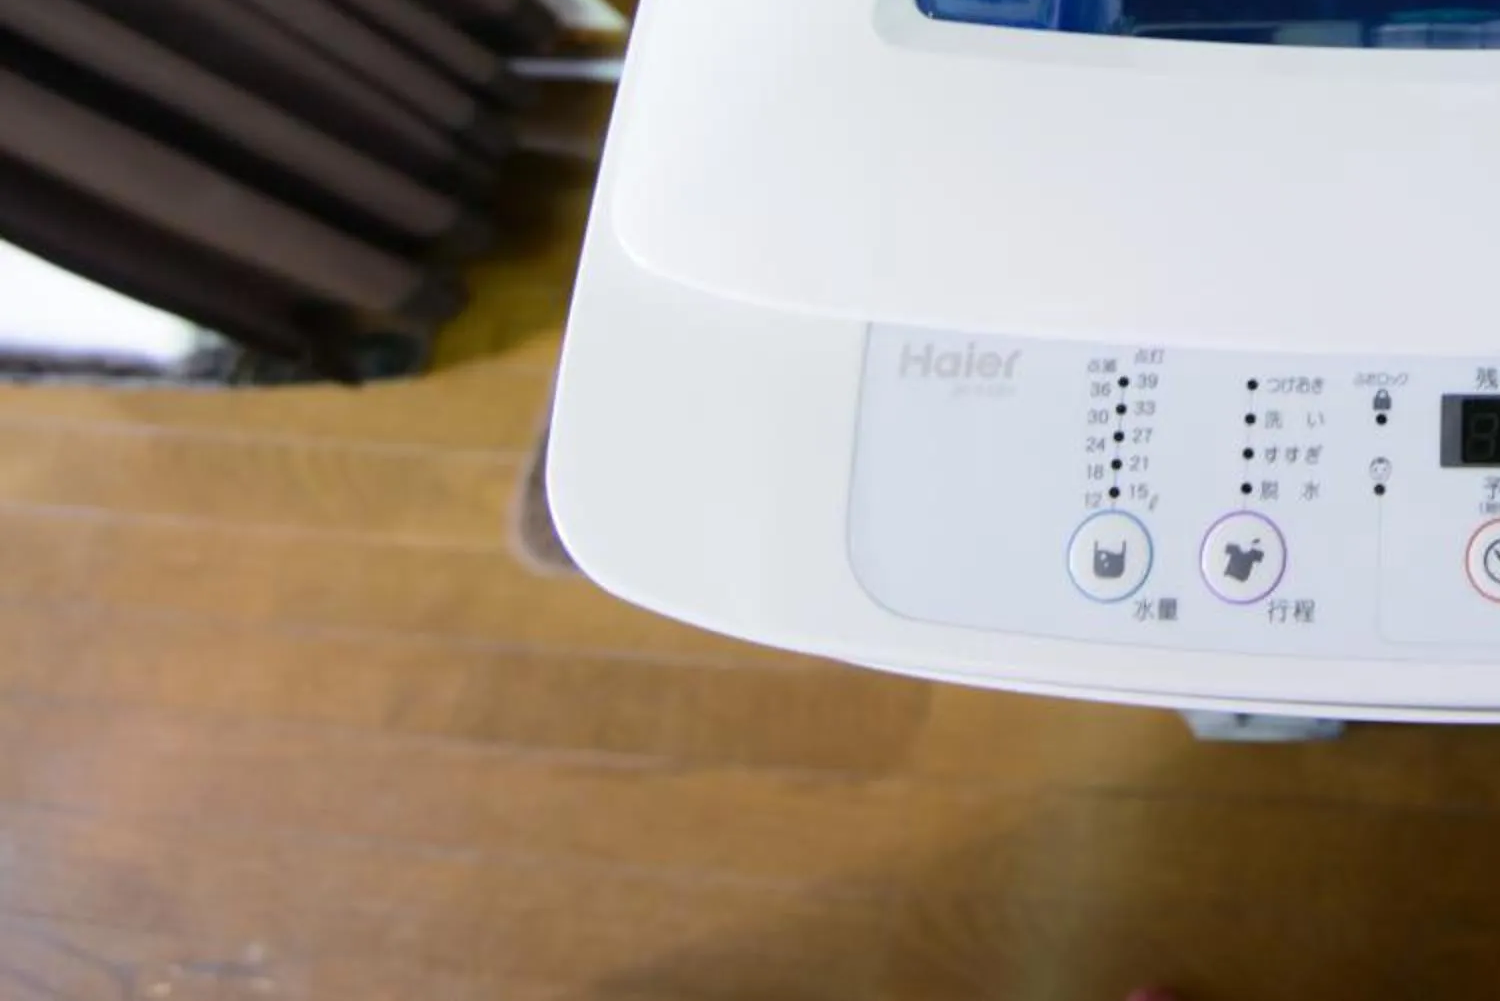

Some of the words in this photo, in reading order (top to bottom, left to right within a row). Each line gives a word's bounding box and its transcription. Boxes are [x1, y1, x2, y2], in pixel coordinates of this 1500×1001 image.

[899, 341, 1023, 379] Haier
[1136, 373, 1158, 389] 39
[1266, 377, 1325, 394] つけおき
[1090, 381, 1112, 398] 36
[1133, 400, 1156, 416] 33
[1087, 409, 1109, 425] 30
[1131, 428, 1153, 444] 27
[1085, 437, 1106, 453] 24
[1264, 445, 1323, 464] すすぎ
[1129, 456, 1149, 471] 21
[1087, 465, 1104, 481] 18
[1130, 483, 1149, 499] 15
[1268, 598, 1316, 624] 行程
